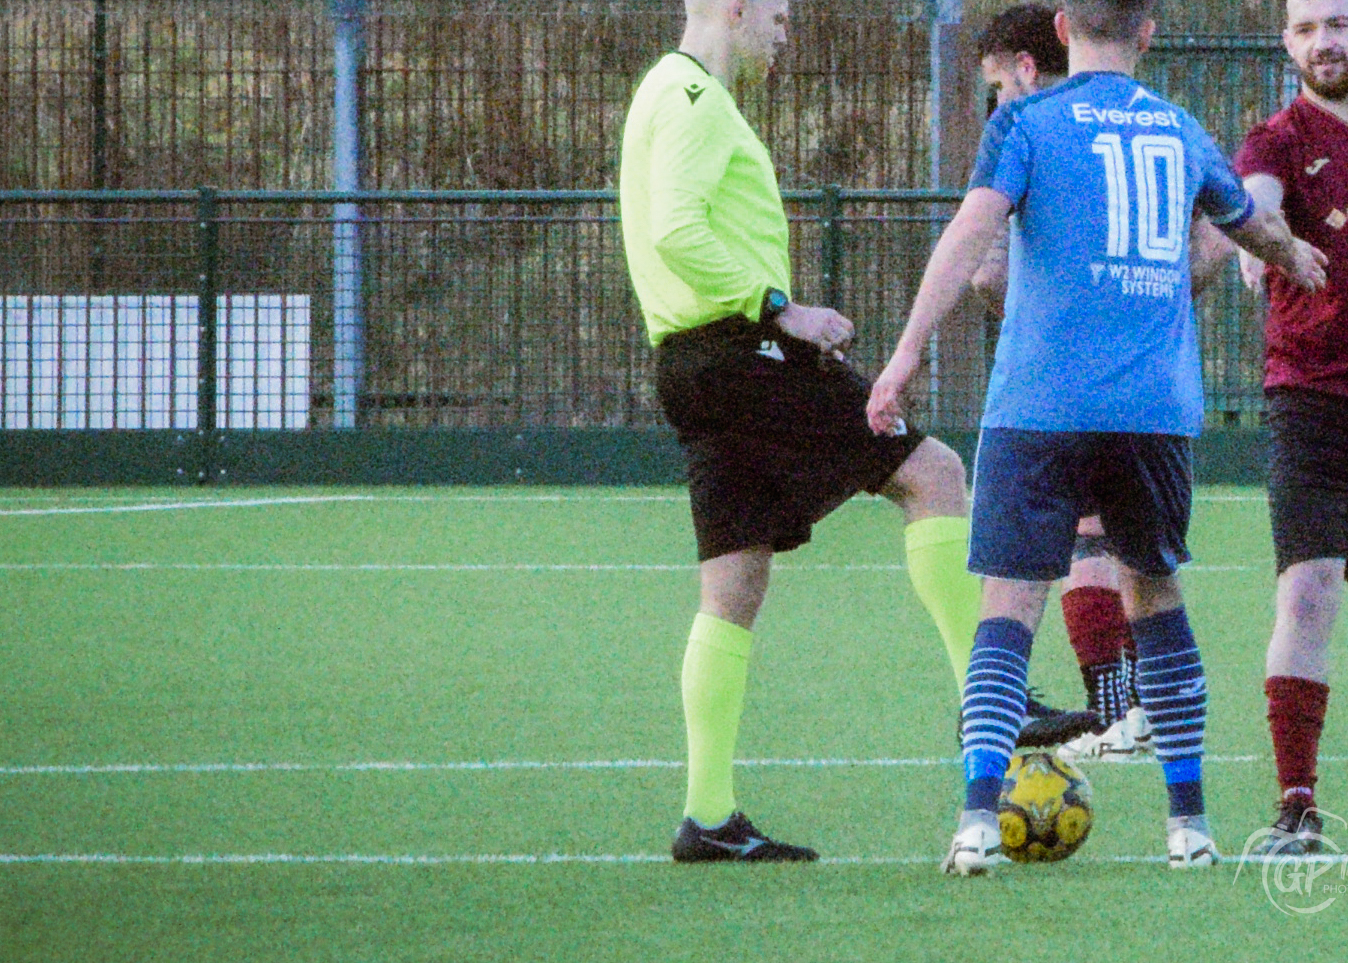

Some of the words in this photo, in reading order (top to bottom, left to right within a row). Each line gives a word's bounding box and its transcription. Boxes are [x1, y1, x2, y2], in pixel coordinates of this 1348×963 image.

[1072, 103, 1180, 128] Everest
[1092, 133, 1184, 262] 10
[1108, 264, 1129, 279] W2
